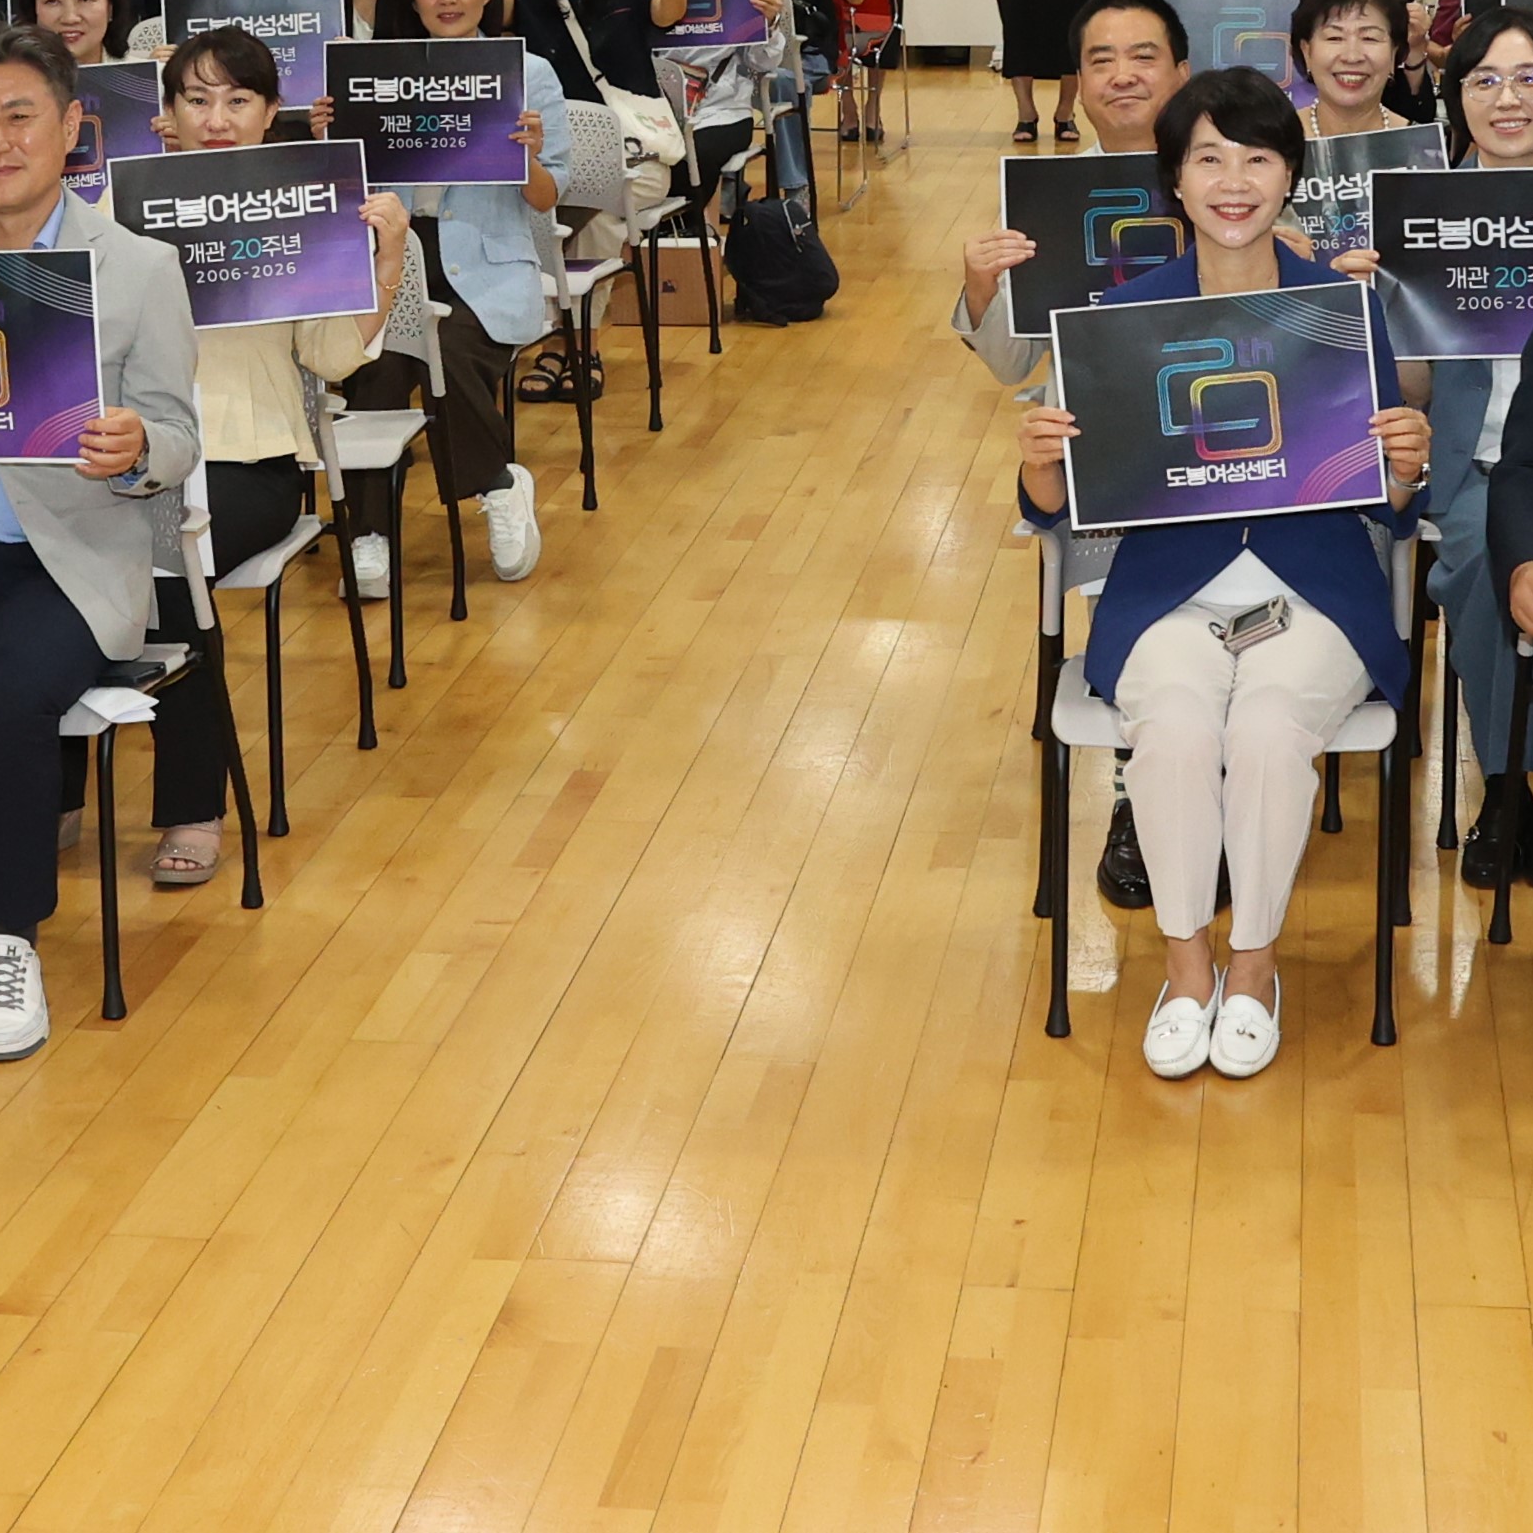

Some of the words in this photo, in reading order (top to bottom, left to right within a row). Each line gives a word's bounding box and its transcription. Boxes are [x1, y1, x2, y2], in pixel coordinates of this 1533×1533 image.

[348, 74, 502, 103] 도봉여성센터
[379, 115, 412, 133] 개관
[415, 113, 472, 133] 20주년
[387, 137, 467, 149] 2006-2026
[142, 183, 338, 230] 도봉여성센터
[184, 241, 227, 264] 개관
[230, 232, 302, 261] 20주년
[195, 261, 297, 284] 2006-2026
[1446, 266, 1489, 290] 개관
[1166, 458, 1287, 488] 도봉여성센터
